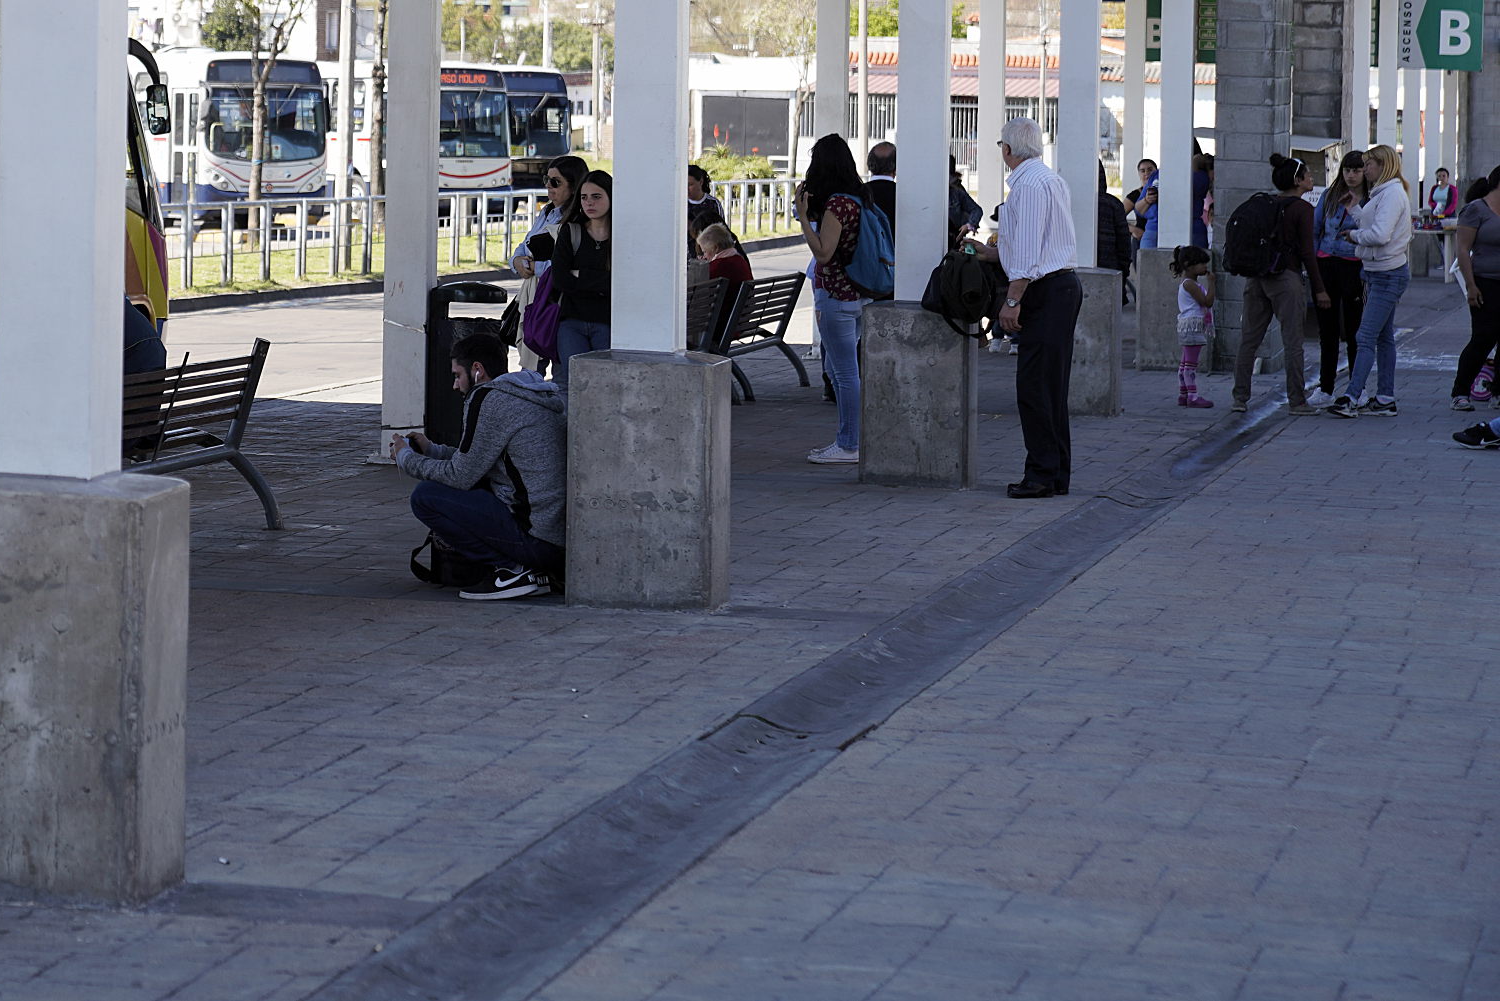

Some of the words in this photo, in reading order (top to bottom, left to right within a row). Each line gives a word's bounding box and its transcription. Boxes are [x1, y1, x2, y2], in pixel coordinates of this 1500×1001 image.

[1402, 1, 1412, 63] ASCENSO
[1439, 10, 1471, 56] B
[458, 73, 487, 84] MOLINO
